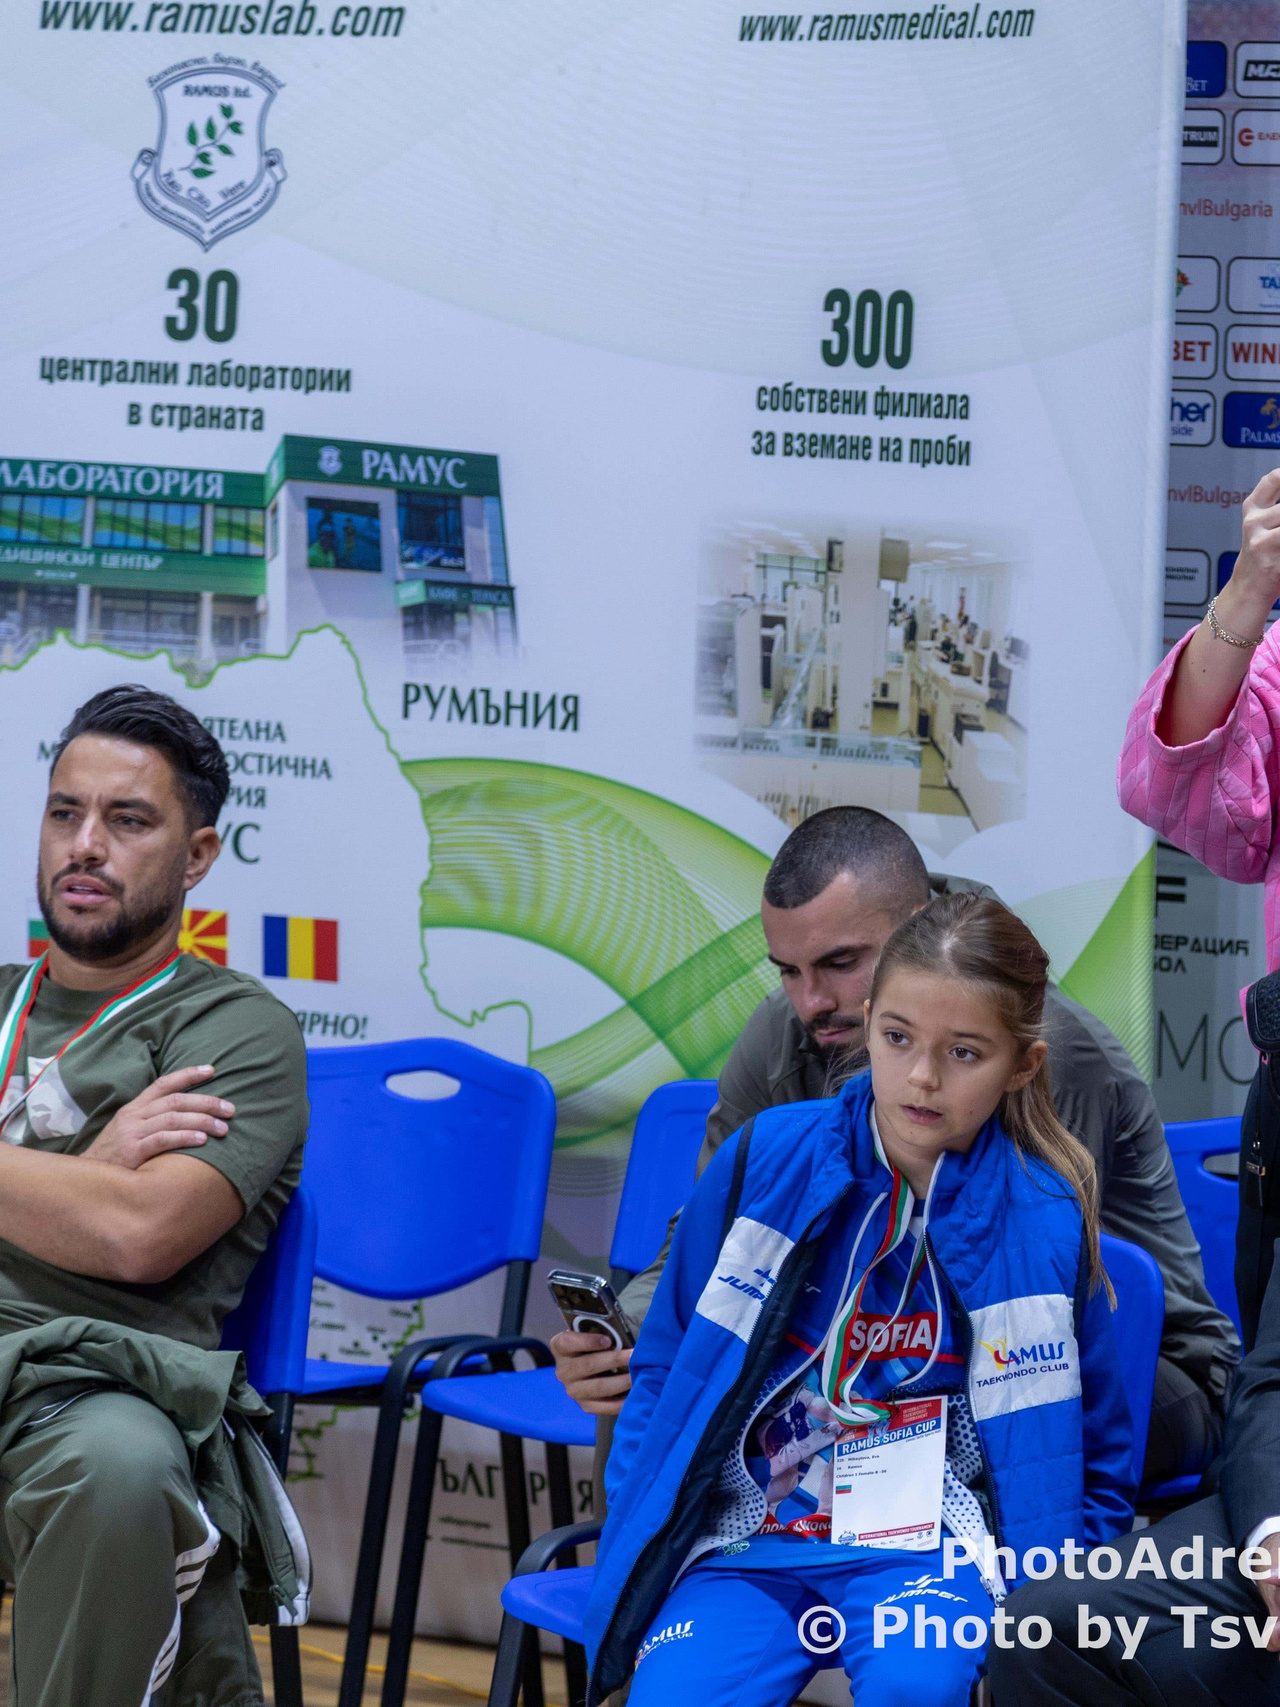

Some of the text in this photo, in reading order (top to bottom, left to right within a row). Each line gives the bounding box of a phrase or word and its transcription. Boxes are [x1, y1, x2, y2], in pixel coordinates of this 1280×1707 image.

[38, 0, 405, 38] www.ramuslab.com
[738, 3, 1036, 42] www.ramusmedical.com
[165, 268, 239, 344] 30
[821, 288, 914, 370] 300
[39, 355, 352, 394] централни лаборатории
[128, 403, 265, 433] в страната
[756, 382, 970, 421] собствени филиала
[751, 430, 971, 468] за вземане на проби
[361, 448, 468, 490] РАМУС
[402, 682, 581, 734] РУМЪНИЯ
[717, 1275, 767, 1306] JUMP
[849, 1318, 934, 1353] SOFIA
[976, 1362, 1070, 1388] TAEKWONDO CLUB
[842, 1436, 880, 1455] RAMUS
[882, 1427, 913, 1444] SOFIA
[915, 1419, 937, 1434] CUP
